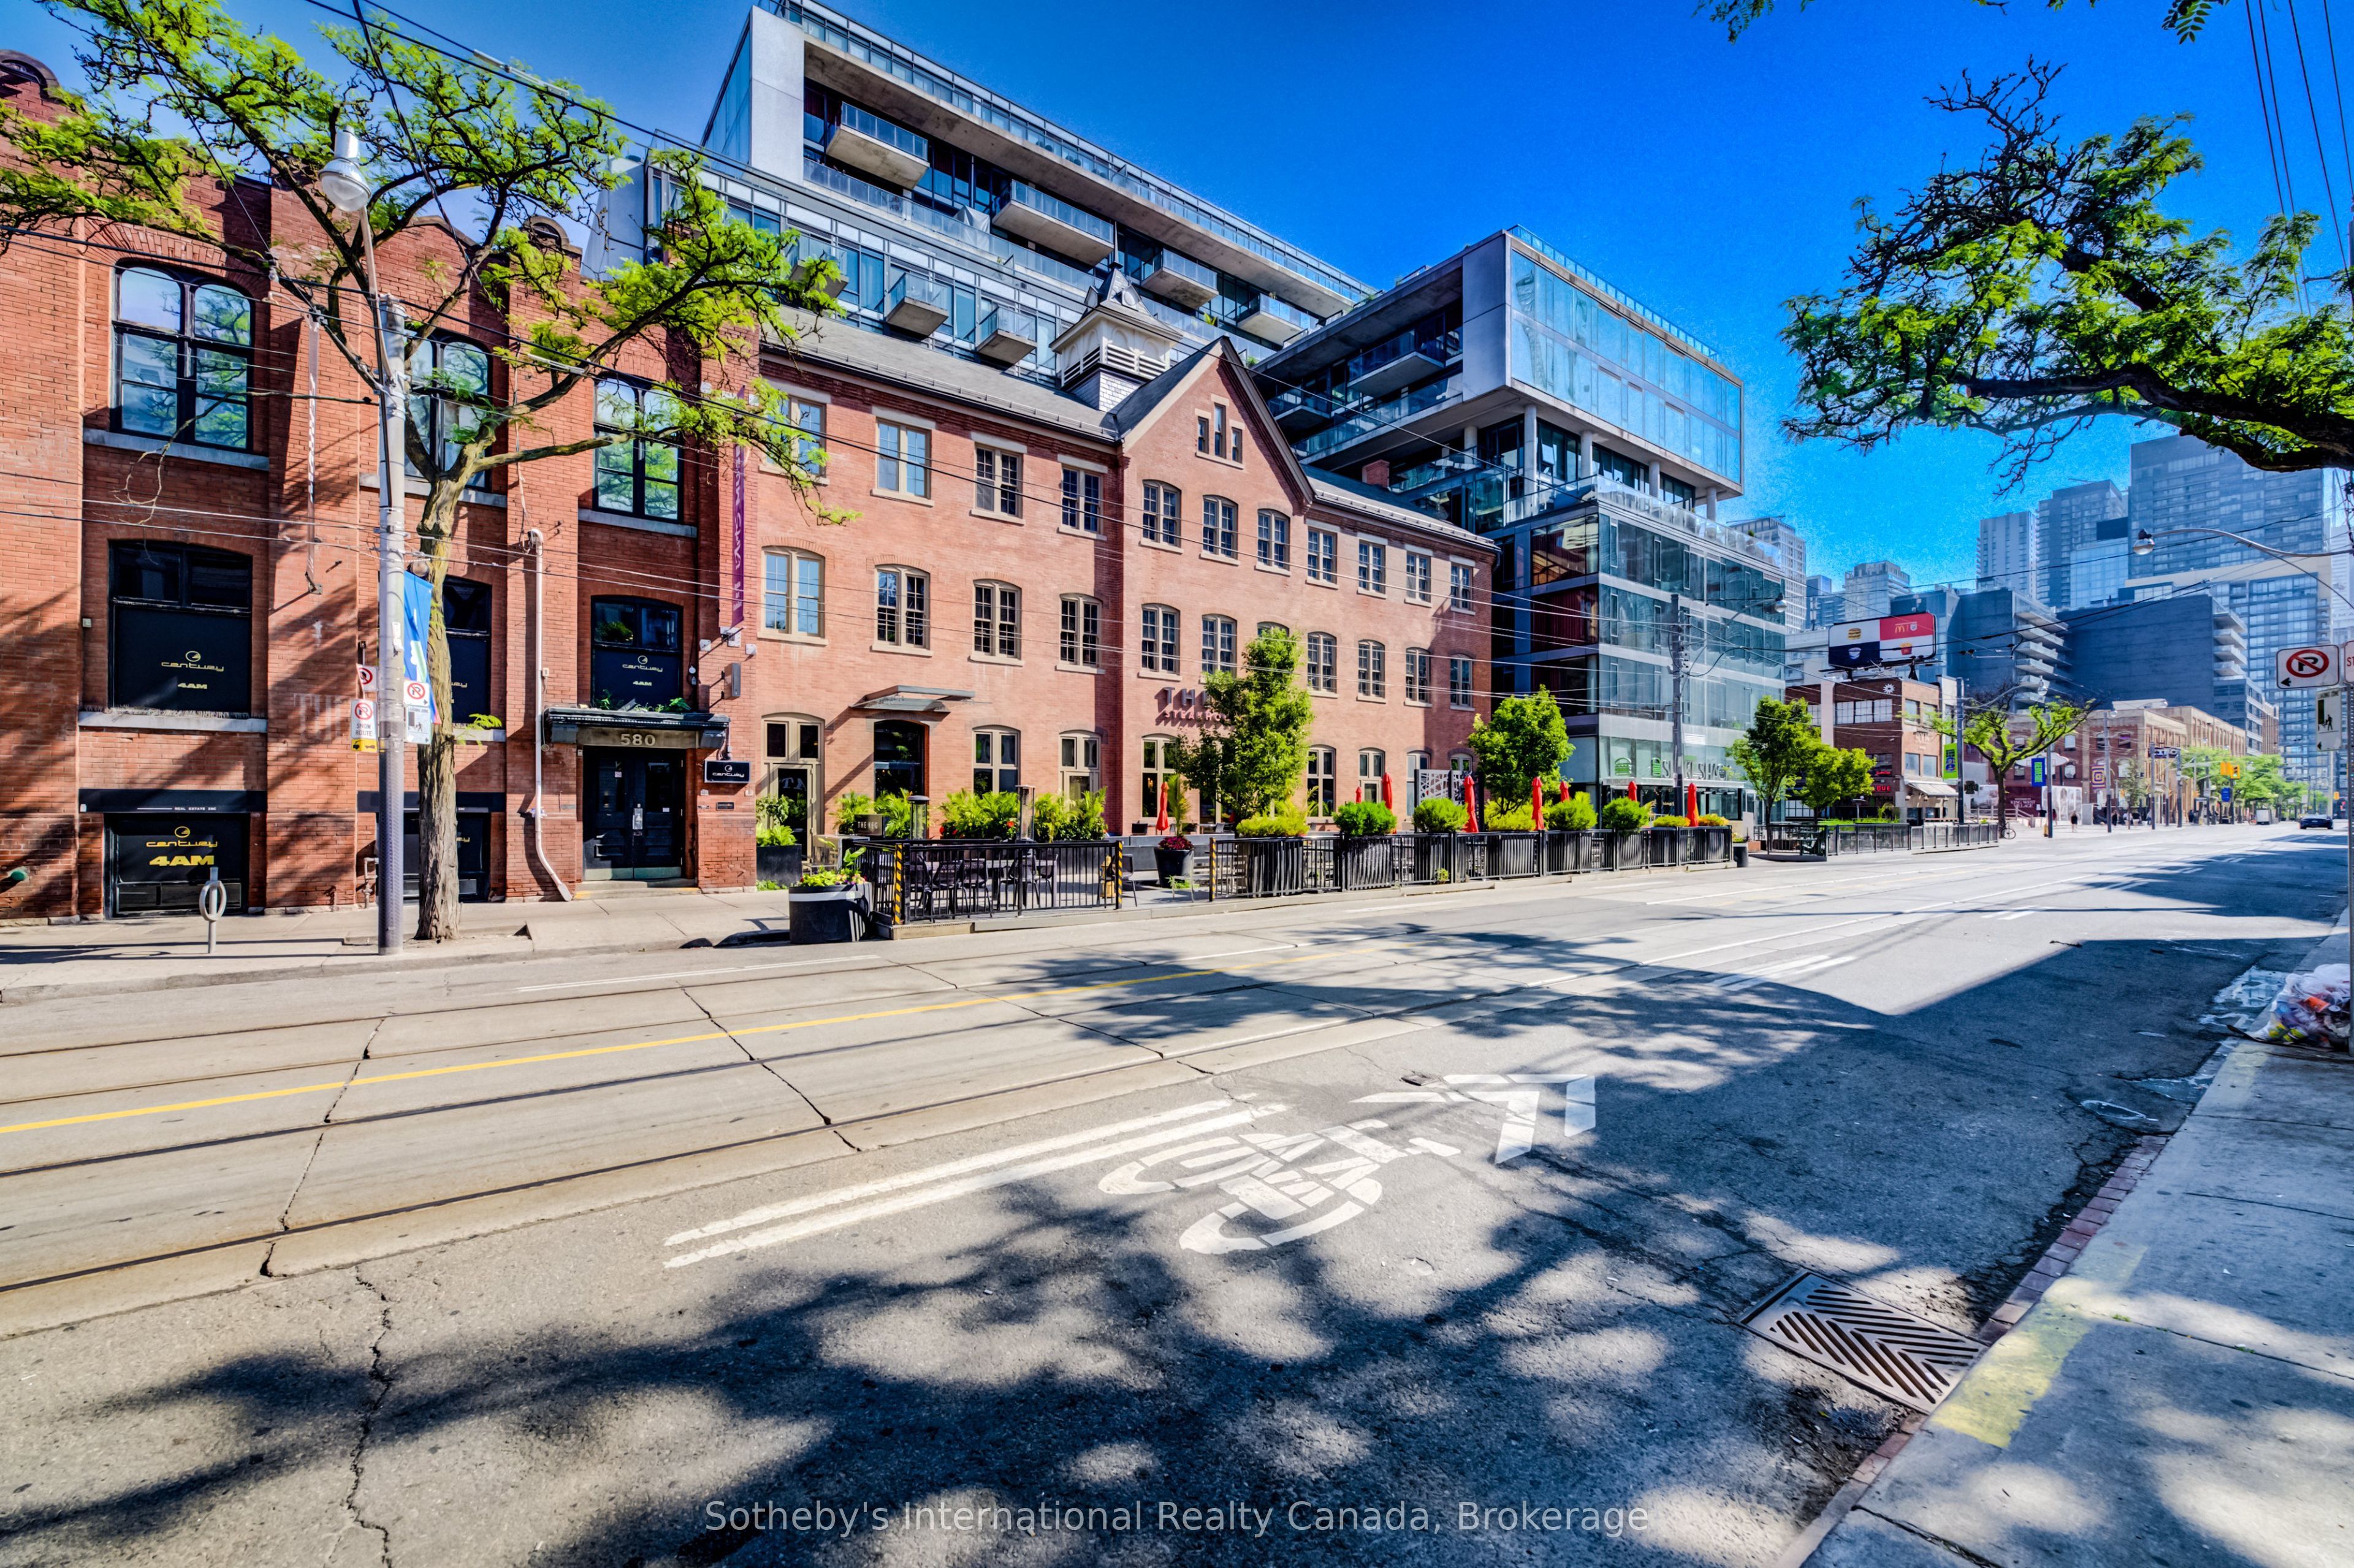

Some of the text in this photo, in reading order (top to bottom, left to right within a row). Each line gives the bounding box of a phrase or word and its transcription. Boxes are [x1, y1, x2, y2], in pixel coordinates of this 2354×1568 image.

[1163, 687, 1207, 706] TH
[620, 733, 656, 747] 580
[149, 855, 215, 866] 4AM
